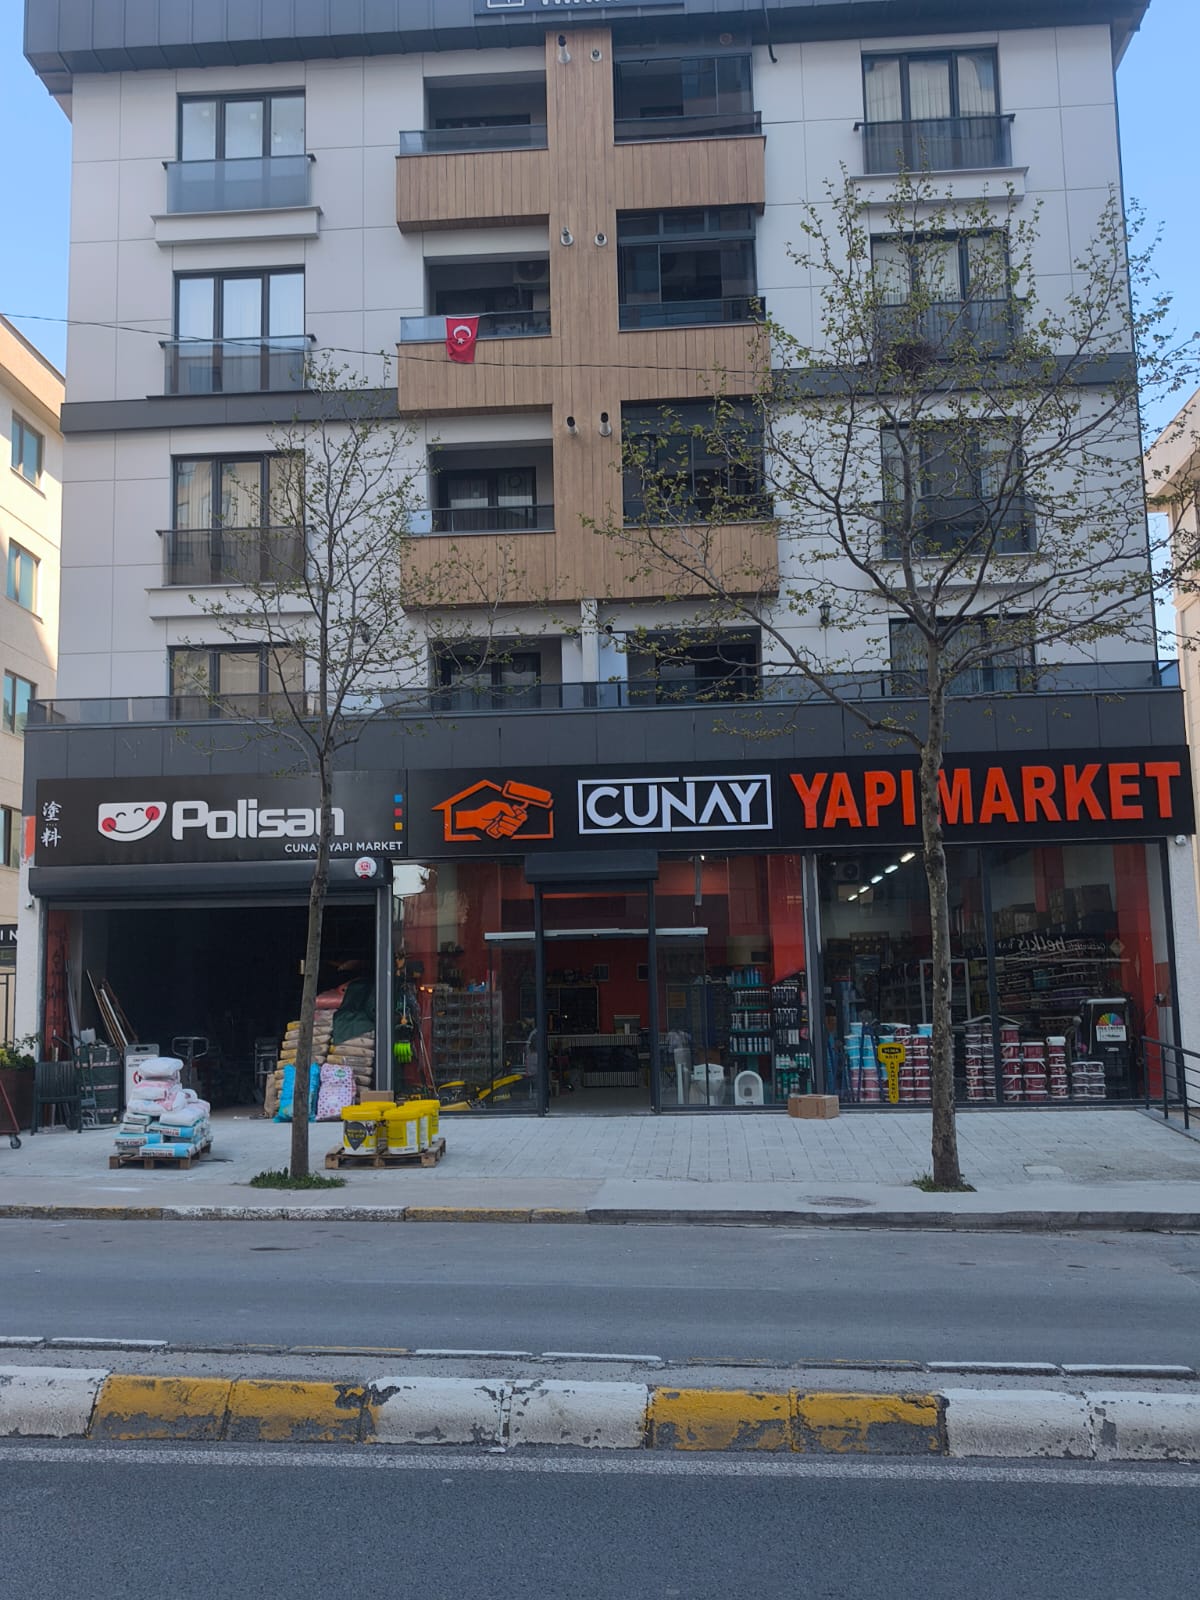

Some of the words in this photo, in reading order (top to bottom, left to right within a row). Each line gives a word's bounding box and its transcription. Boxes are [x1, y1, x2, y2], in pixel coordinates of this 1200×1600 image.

[586, 782, 762, 829] CUNAY
[790, 769, 917, 829] YAPI
[938, 762, 1181, 825] MARKET
[41, 800, 62, 848] 塗料
[172, 798, 345, 841] Polisan
[284, 842, 320, 853] CUNA
[329, 842, 353, 852] YAPI
[356, 841, 403, 852] MARKET
